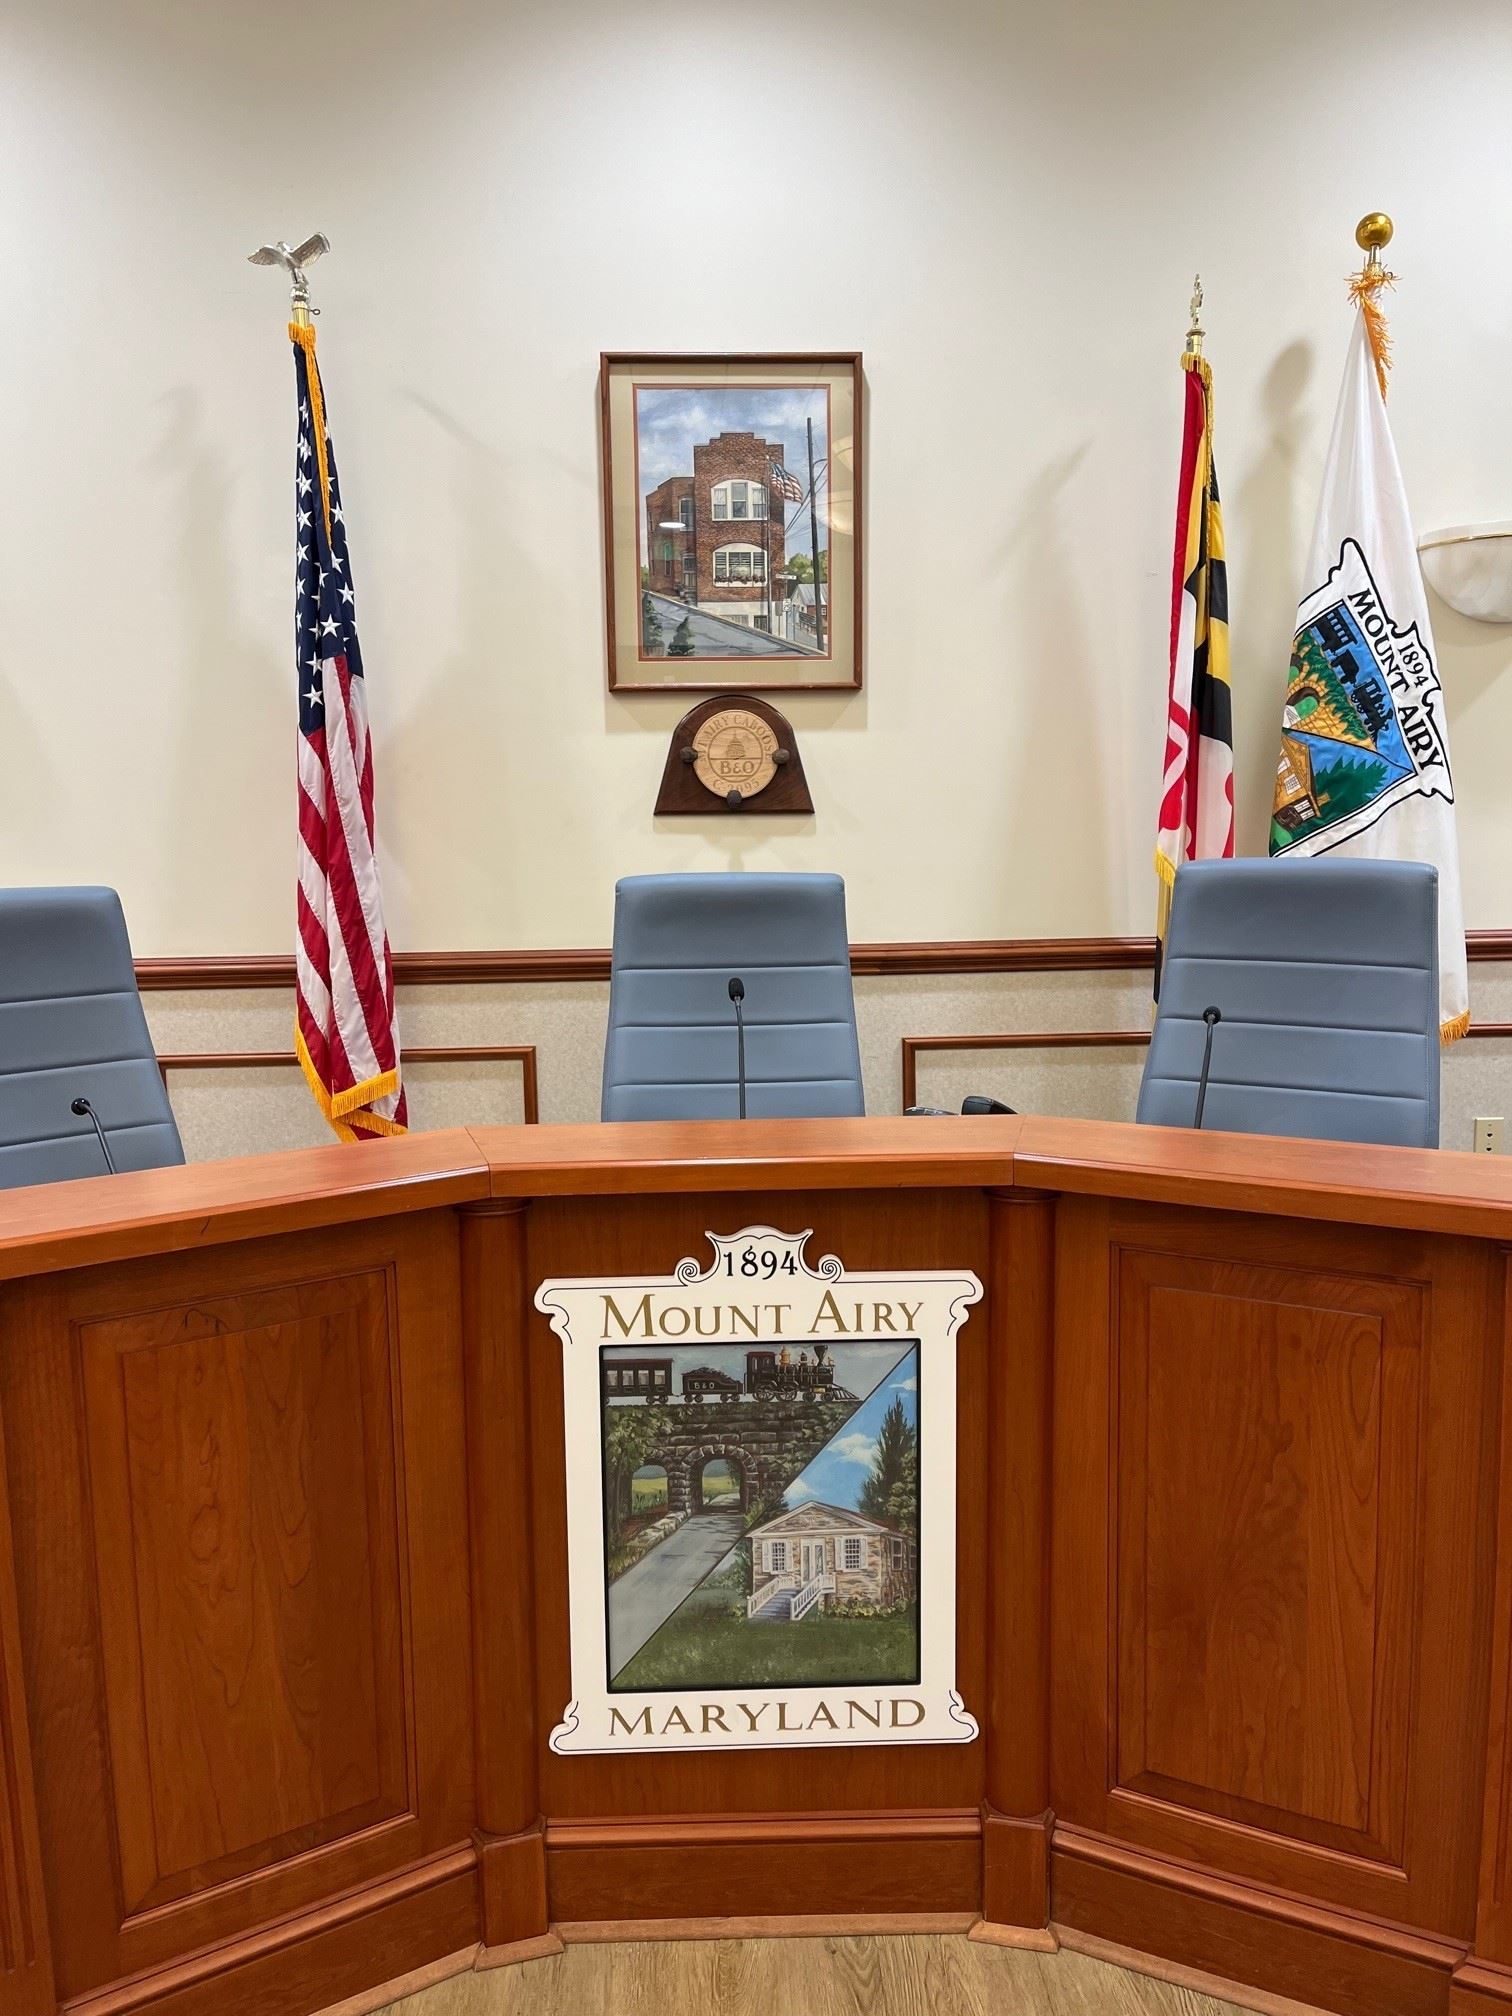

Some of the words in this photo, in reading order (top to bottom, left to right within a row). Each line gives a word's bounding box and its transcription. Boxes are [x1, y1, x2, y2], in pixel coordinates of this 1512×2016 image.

[1347, 588, 1409, 693] MOUNT
[1398, 704, 1444, 770] AIRY
[1398, 641, 1429, 688] 1894
[722, 1245, 799, 1281] 1894
[599, 1293, 792, 1339] MOUNT
[807, 1289, 925, 1335] AIRY
[607, 1699, 926, 1737] MARYLAND
